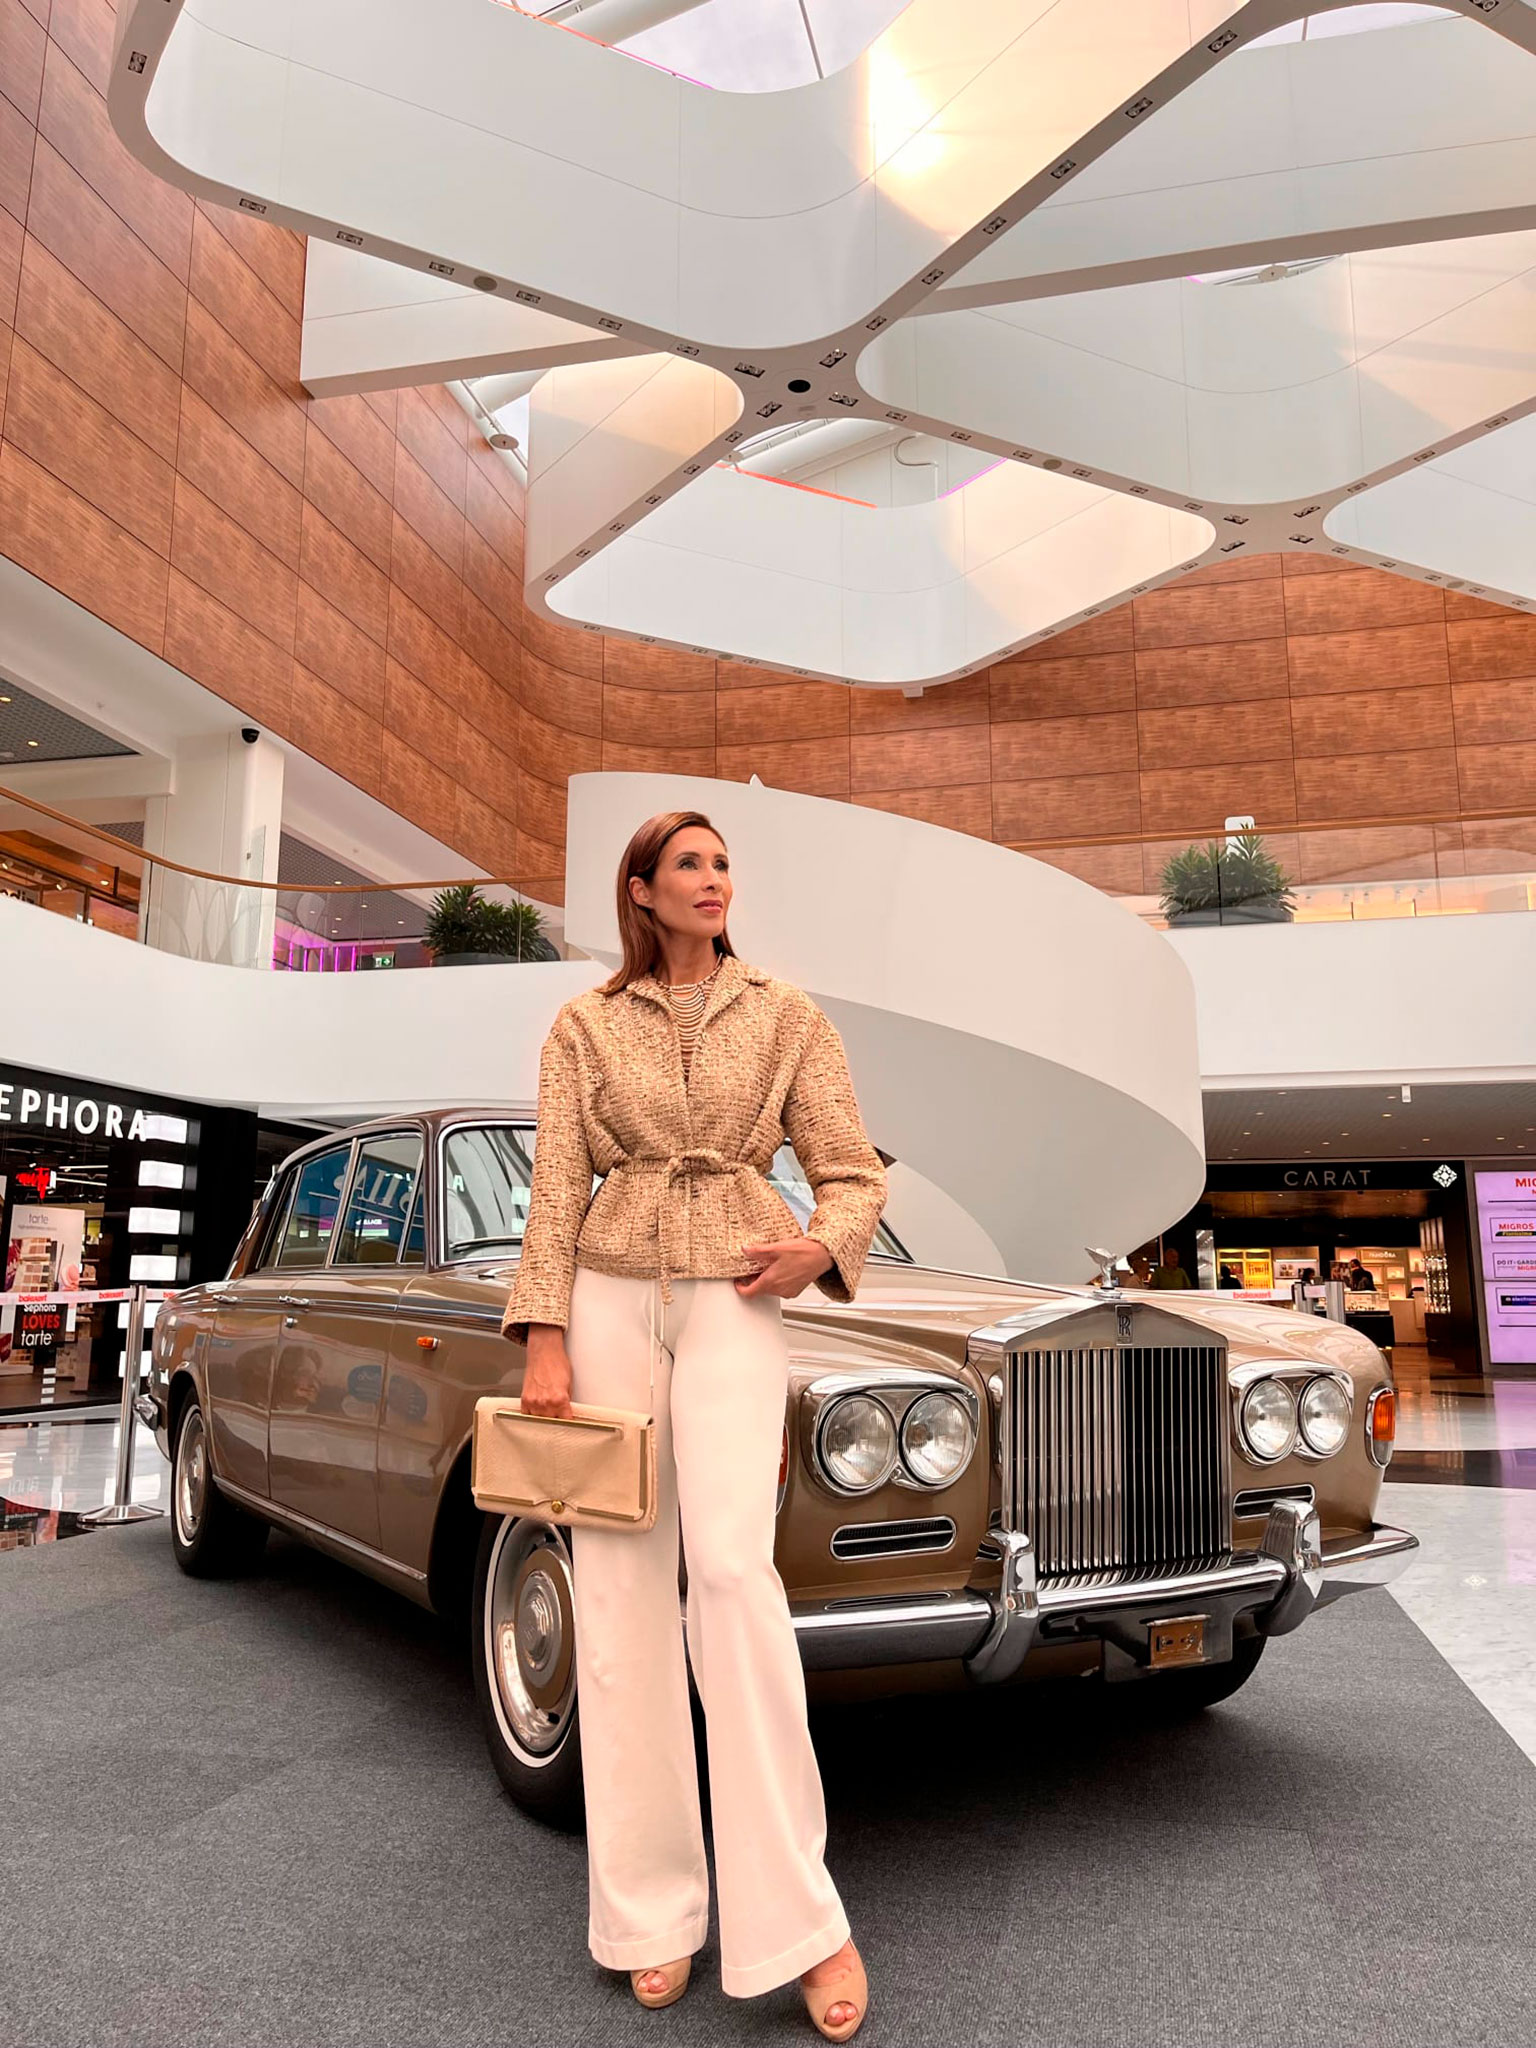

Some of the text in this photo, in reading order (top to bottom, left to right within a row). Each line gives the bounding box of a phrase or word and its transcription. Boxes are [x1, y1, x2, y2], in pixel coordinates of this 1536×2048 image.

[1284, 1169, 1371, 1187] CARAT
[28, 1213, 49, 1225] tarte
[1498, 1222, 1535, 1230] MIGROS
[23, 1303, 57, 1314] Sephora
[22, 1314, 60, 1330] LOVES
[21, 1329, 53, 1347] tarte
